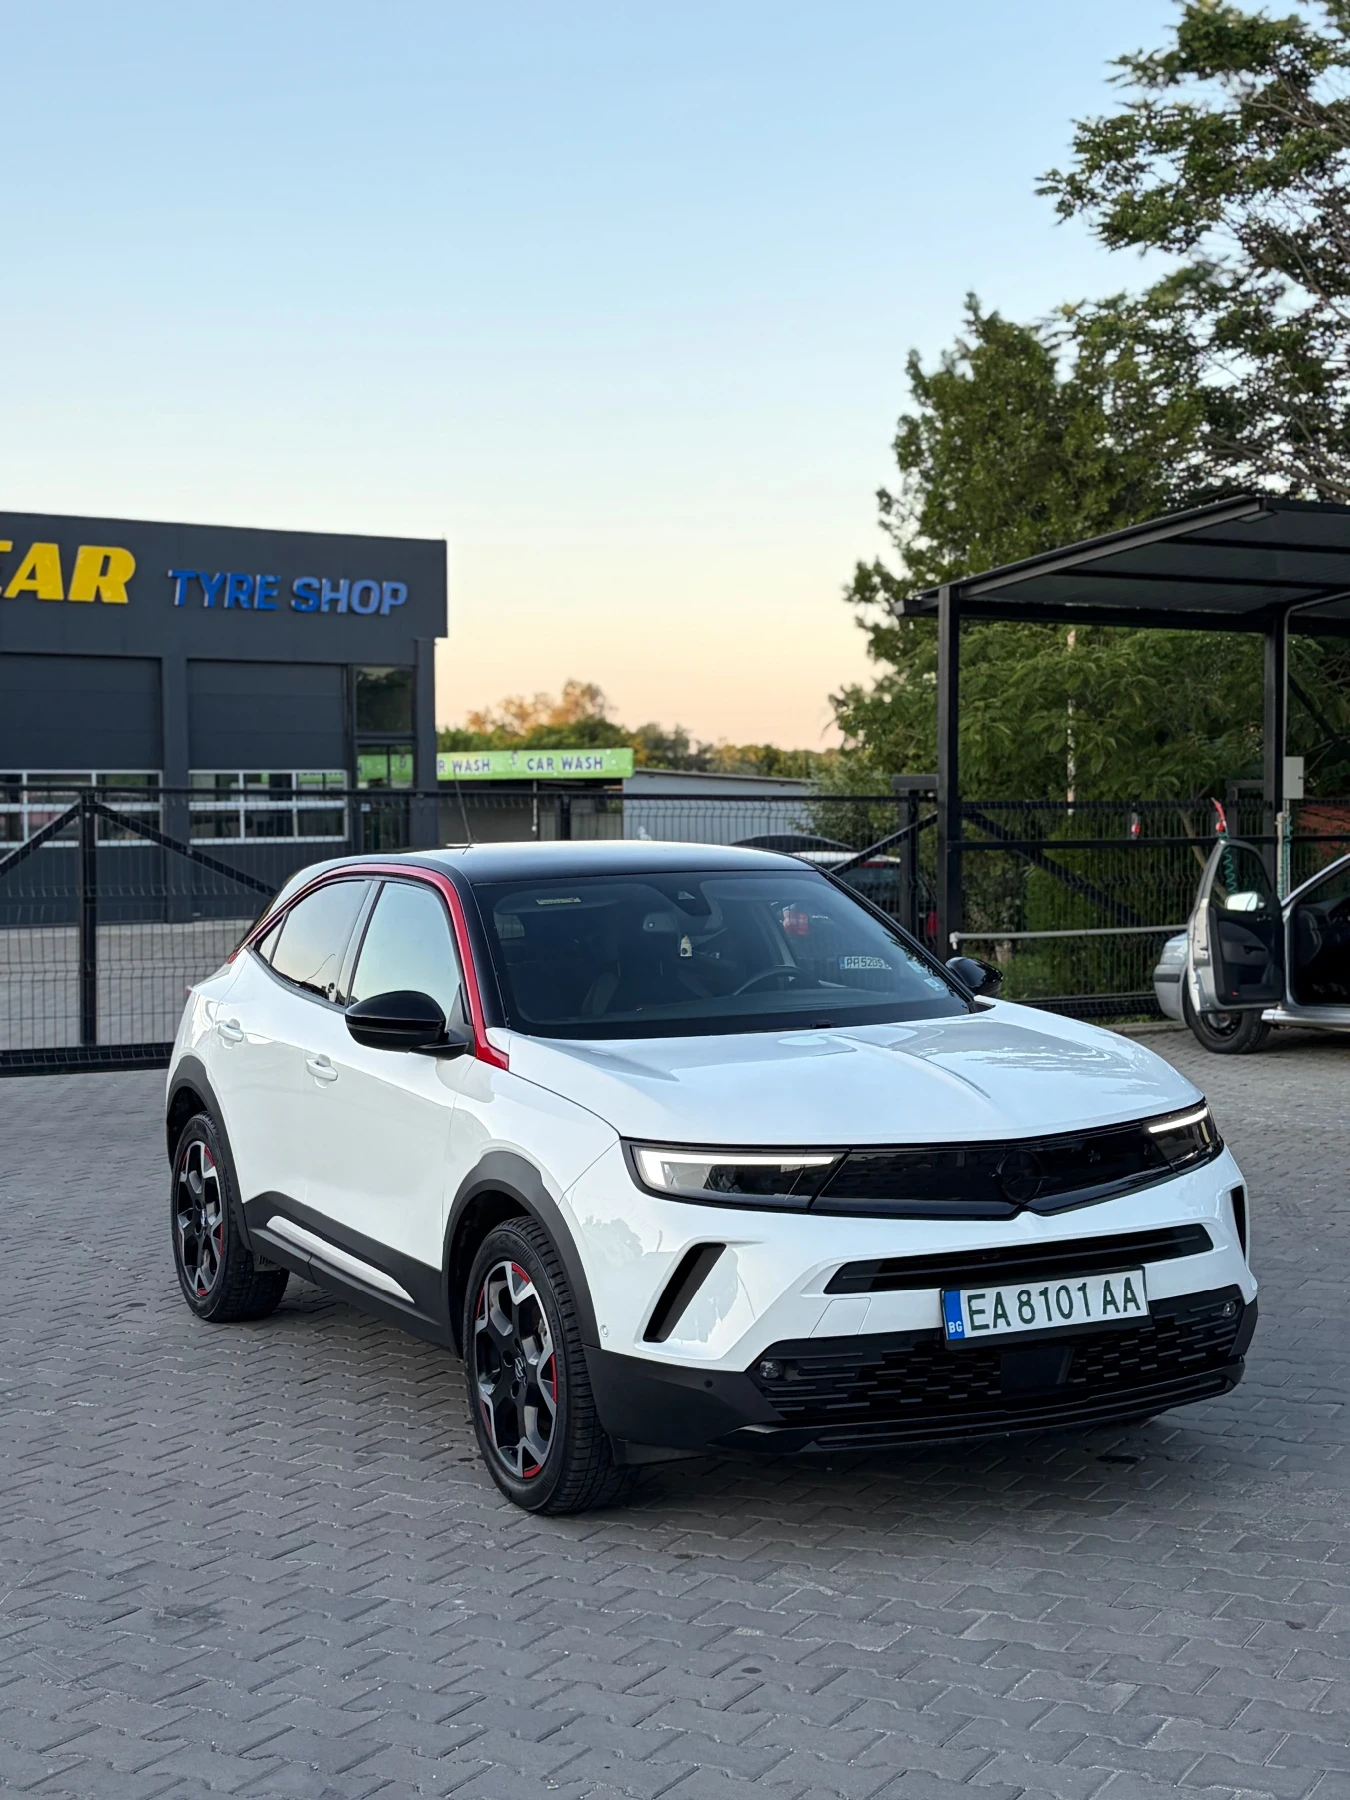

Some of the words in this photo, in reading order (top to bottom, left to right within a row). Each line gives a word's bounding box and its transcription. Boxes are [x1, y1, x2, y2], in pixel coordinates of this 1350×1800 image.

[0, 540, 136, 604] AR
[168, 569, 281, 610] TYRE
[290, 576, 408, 615] SHOP
[452, 759, 490, 772] WASH
[527, 758, 554, 771] CAR
[561, 756, 603, 770] WASH
[948, 1321, 963, 1333] BG
